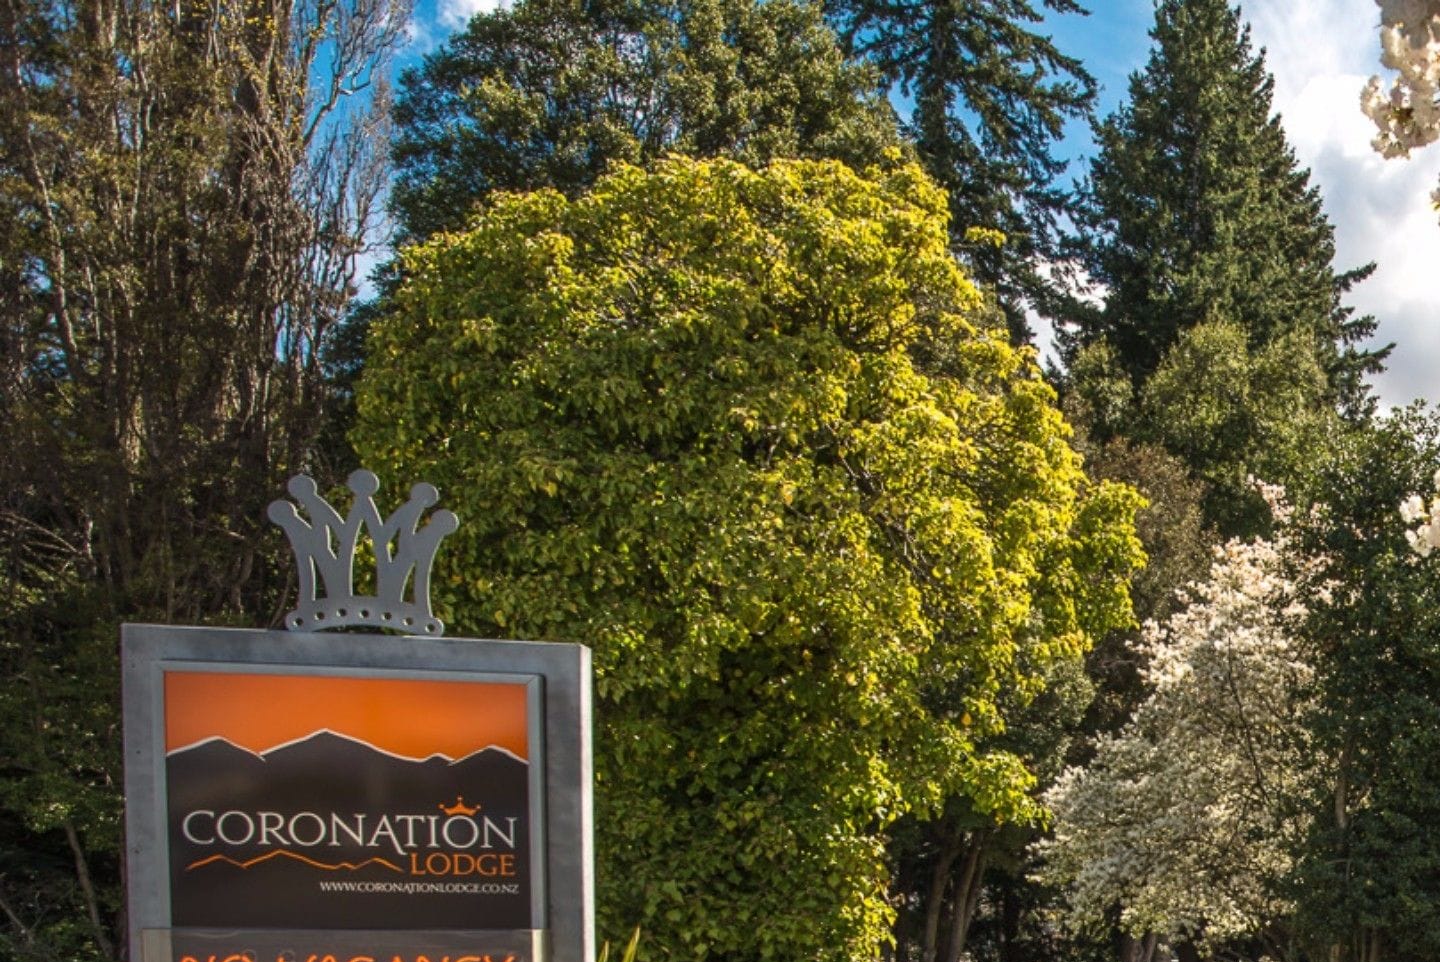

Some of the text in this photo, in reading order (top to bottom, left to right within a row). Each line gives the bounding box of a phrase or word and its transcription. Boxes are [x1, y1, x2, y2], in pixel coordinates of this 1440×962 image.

[182, 810, 517, 856] CORONATION
[410, 852, 516, 876] LODGE
[319, 880, 519, 895] WWW.CORONATIONLODGE.CO.NZ
